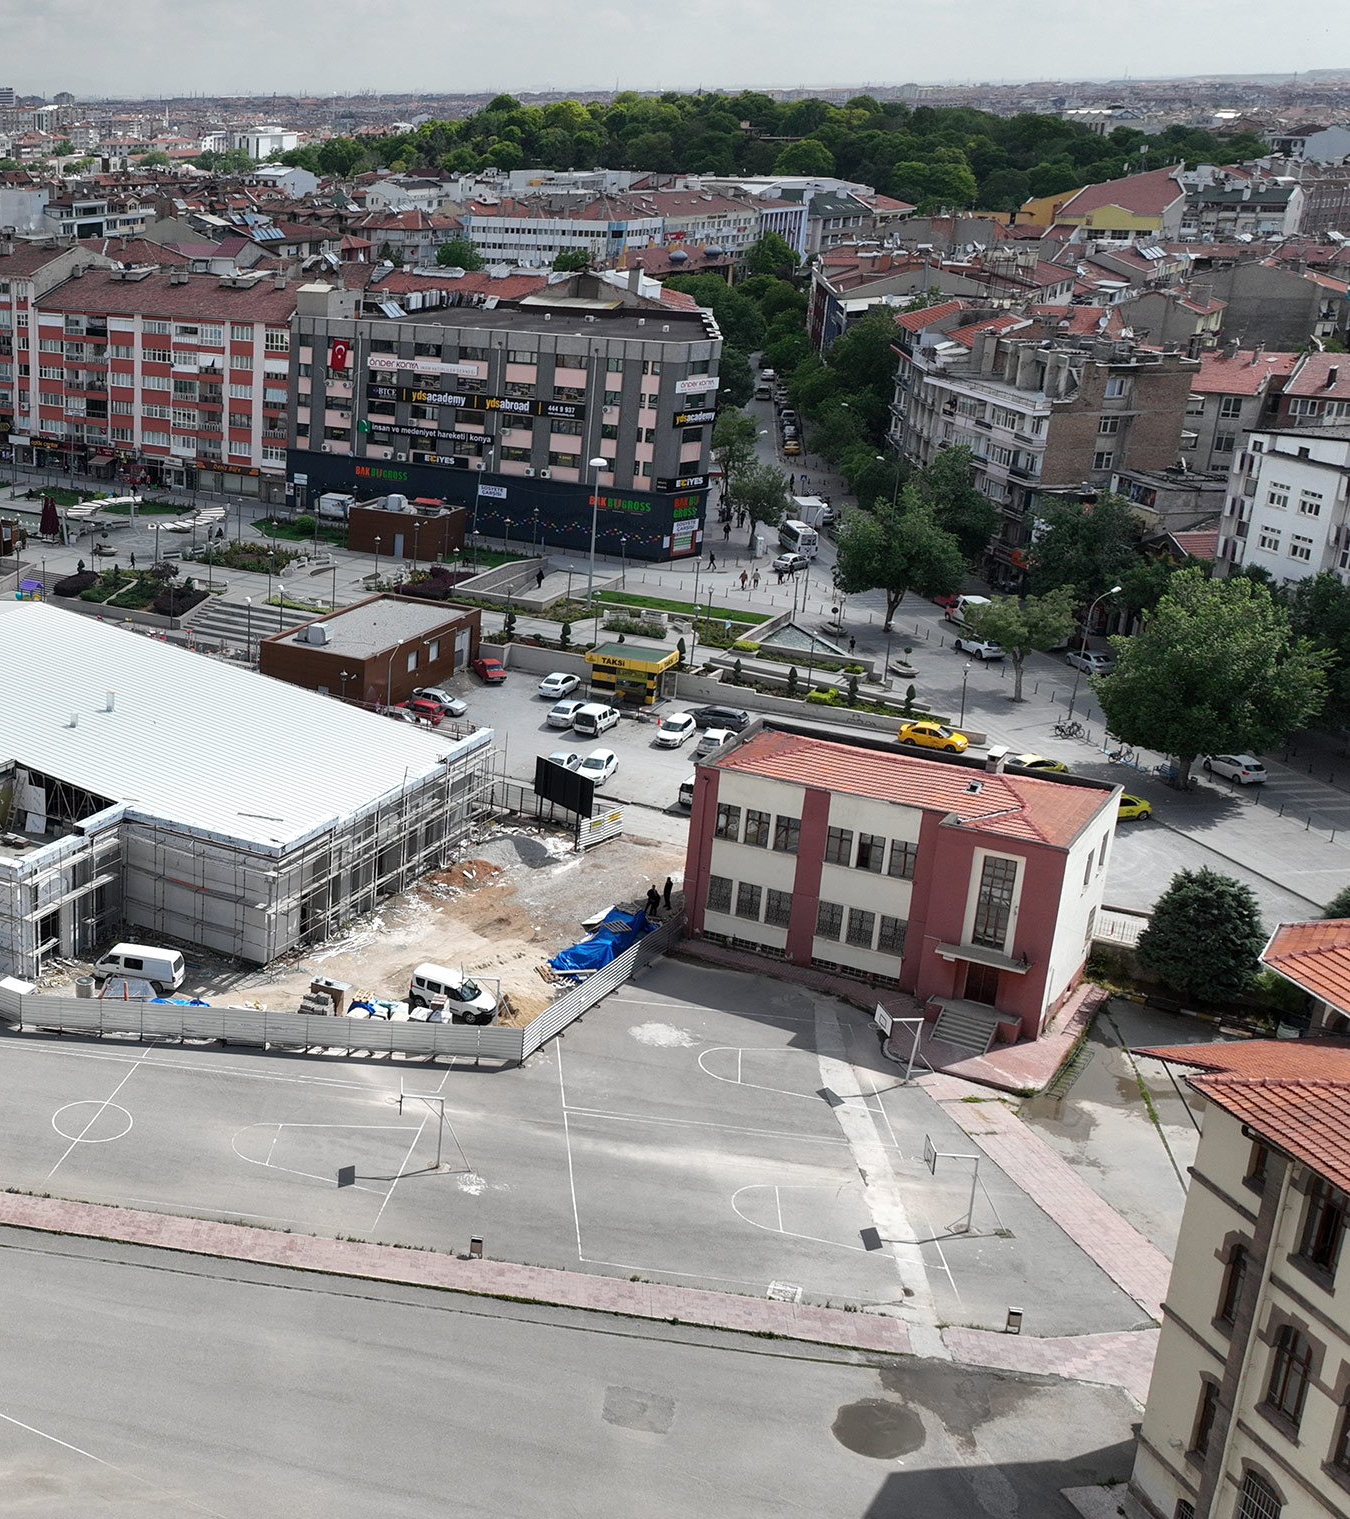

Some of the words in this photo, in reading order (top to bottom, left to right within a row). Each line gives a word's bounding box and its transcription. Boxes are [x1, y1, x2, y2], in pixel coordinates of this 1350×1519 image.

[412, 390, 466, 407] ydsacademy
[485, 397, 530, 412] ydsabroad
[547, 405, 559, 413] 444
[564, 406, 576, 414] 937
[401, 427, 436, 438] medeniyet
[437, 430, 466, 440] hareketi
[469, 433, 492, 444] konya
[673, 507, 697, 519] GROSS
[601, 657, 625, 667] TAKSİ
